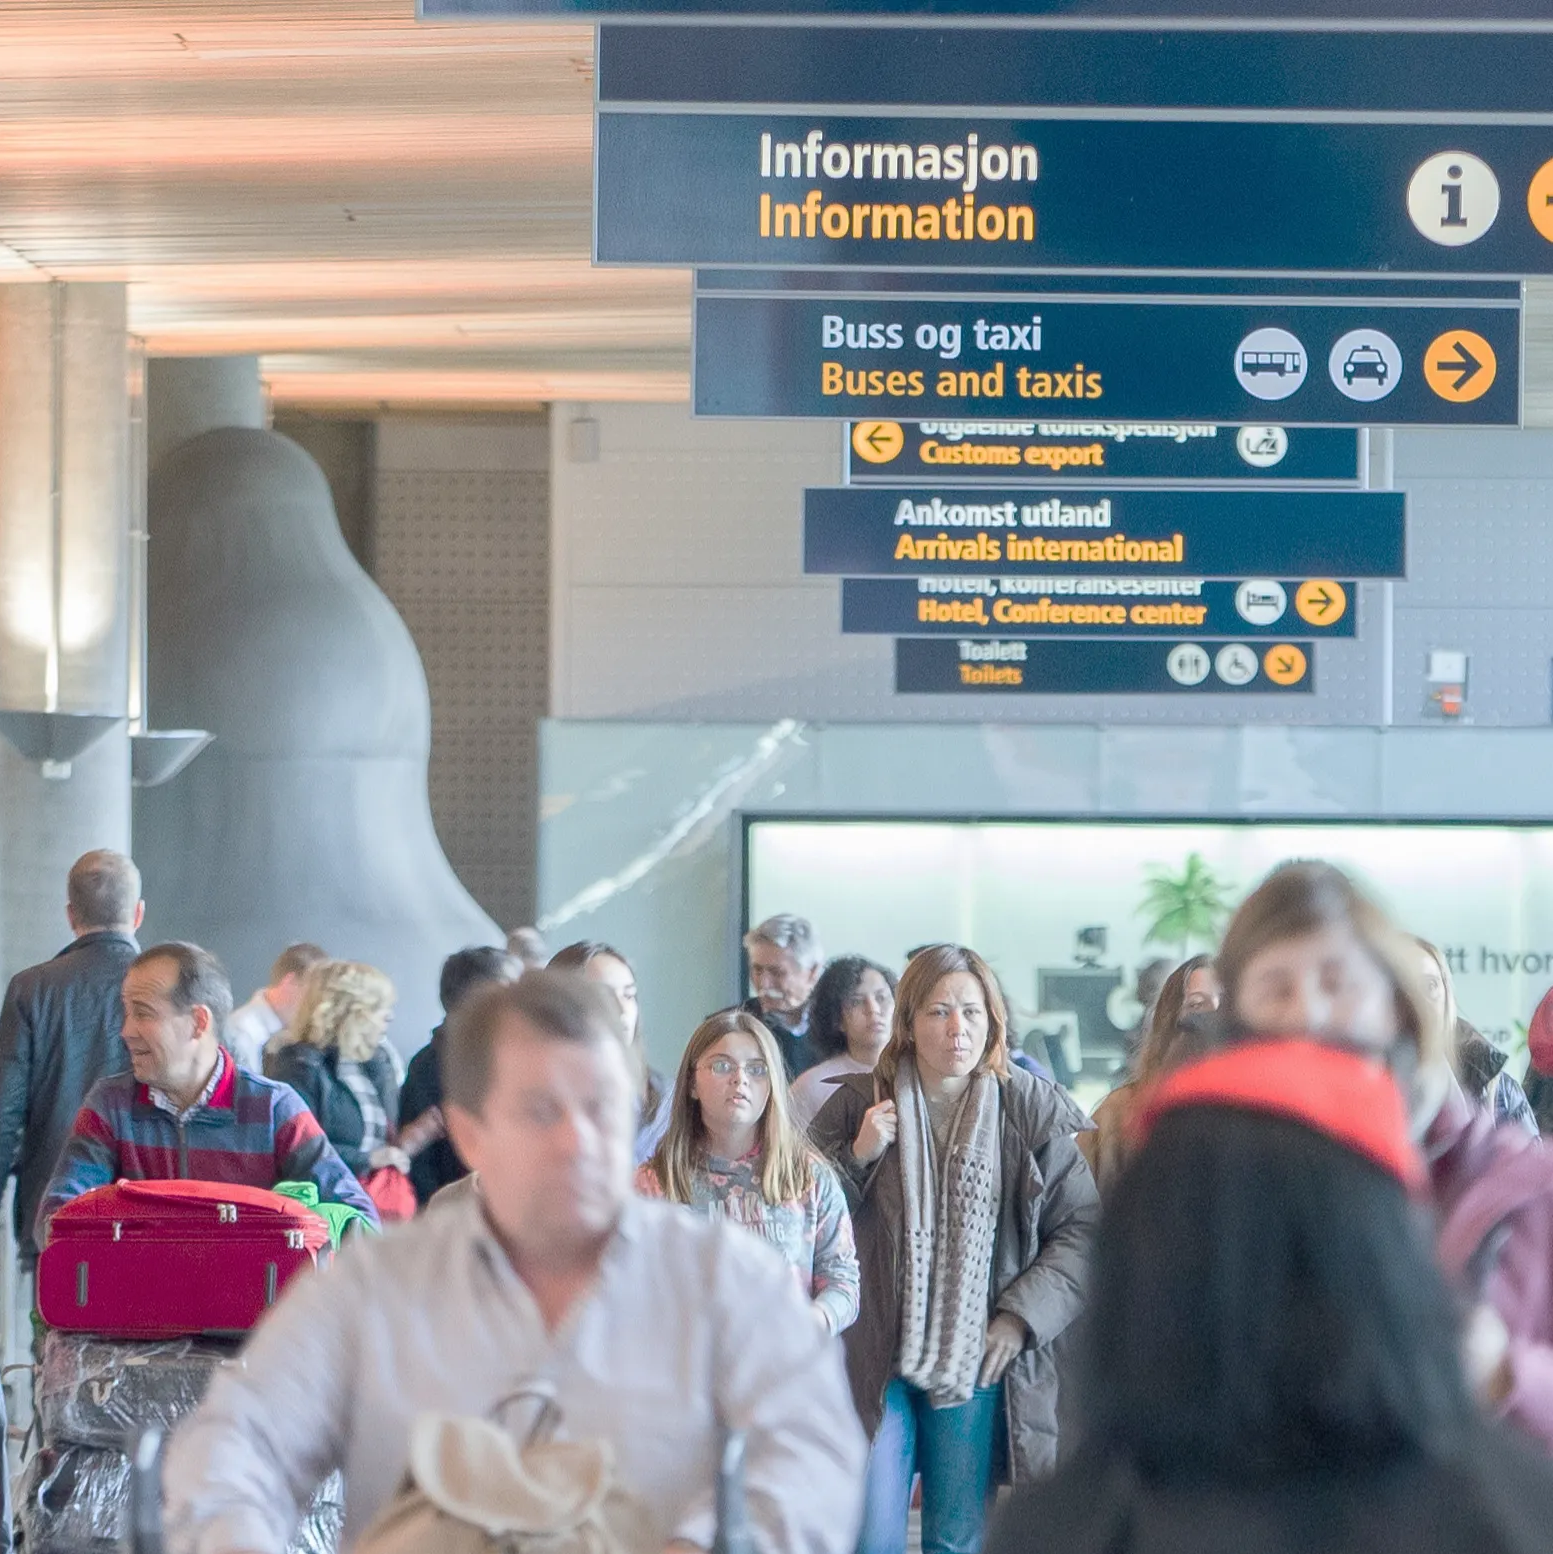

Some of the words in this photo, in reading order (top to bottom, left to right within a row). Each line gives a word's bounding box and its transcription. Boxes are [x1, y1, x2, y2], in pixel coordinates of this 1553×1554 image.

[760, 132, 1038, 192] Informasjon
[759, 191, 1034, 241] Information
[822, 315, 903, 349] Buss
[915, 324, 961, 359] og
[973, 317, 1041, 351] taxi
[821, 362, 925, 397] Buses
[936, 362, 1004, 397] and
[1016, 364, 1103, 399] taxis
[919, 440, 1021, 465] Customs
[1024, 443, 1104, 471] export
[894, 497, 1018, 527] Ankomst
[1021, 499, 1111, 527] utland
[894, 532, 1002, 562] Arrivals
[1006, 533, 1184, 563] international
[917, 597, 990, 626] Hotel,
[992, 598, 1127, 625] Conference
[1129, 602, 1207, 625] center
[957, 640, 1028, 661] Toalett
[958, 663, 1023, 685] Toilets
